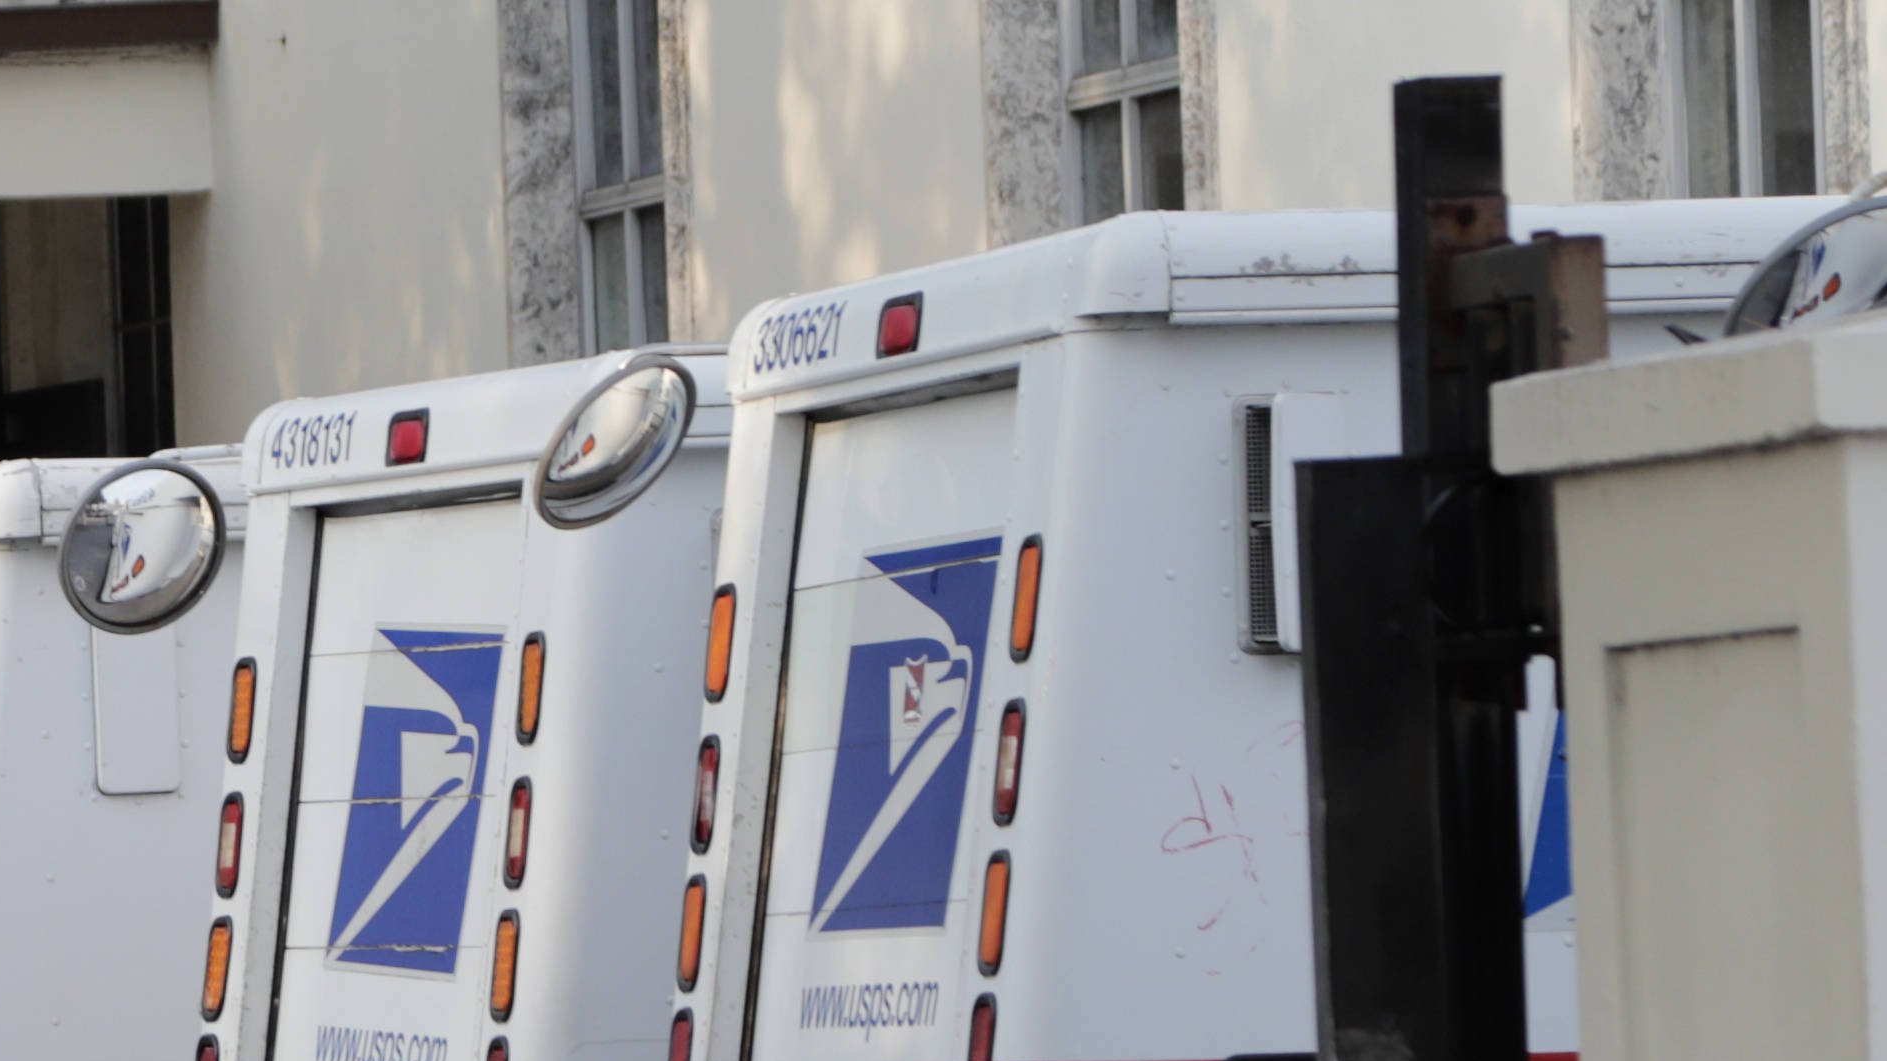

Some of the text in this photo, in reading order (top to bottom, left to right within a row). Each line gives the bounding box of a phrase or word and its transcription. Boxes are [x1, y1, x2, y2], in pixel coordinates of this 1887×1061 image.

[754, 300, 847, 374] 3306621
[271, 410, 357, 468] 4318131
[800, 981, 939, 1042] www.usps.com
